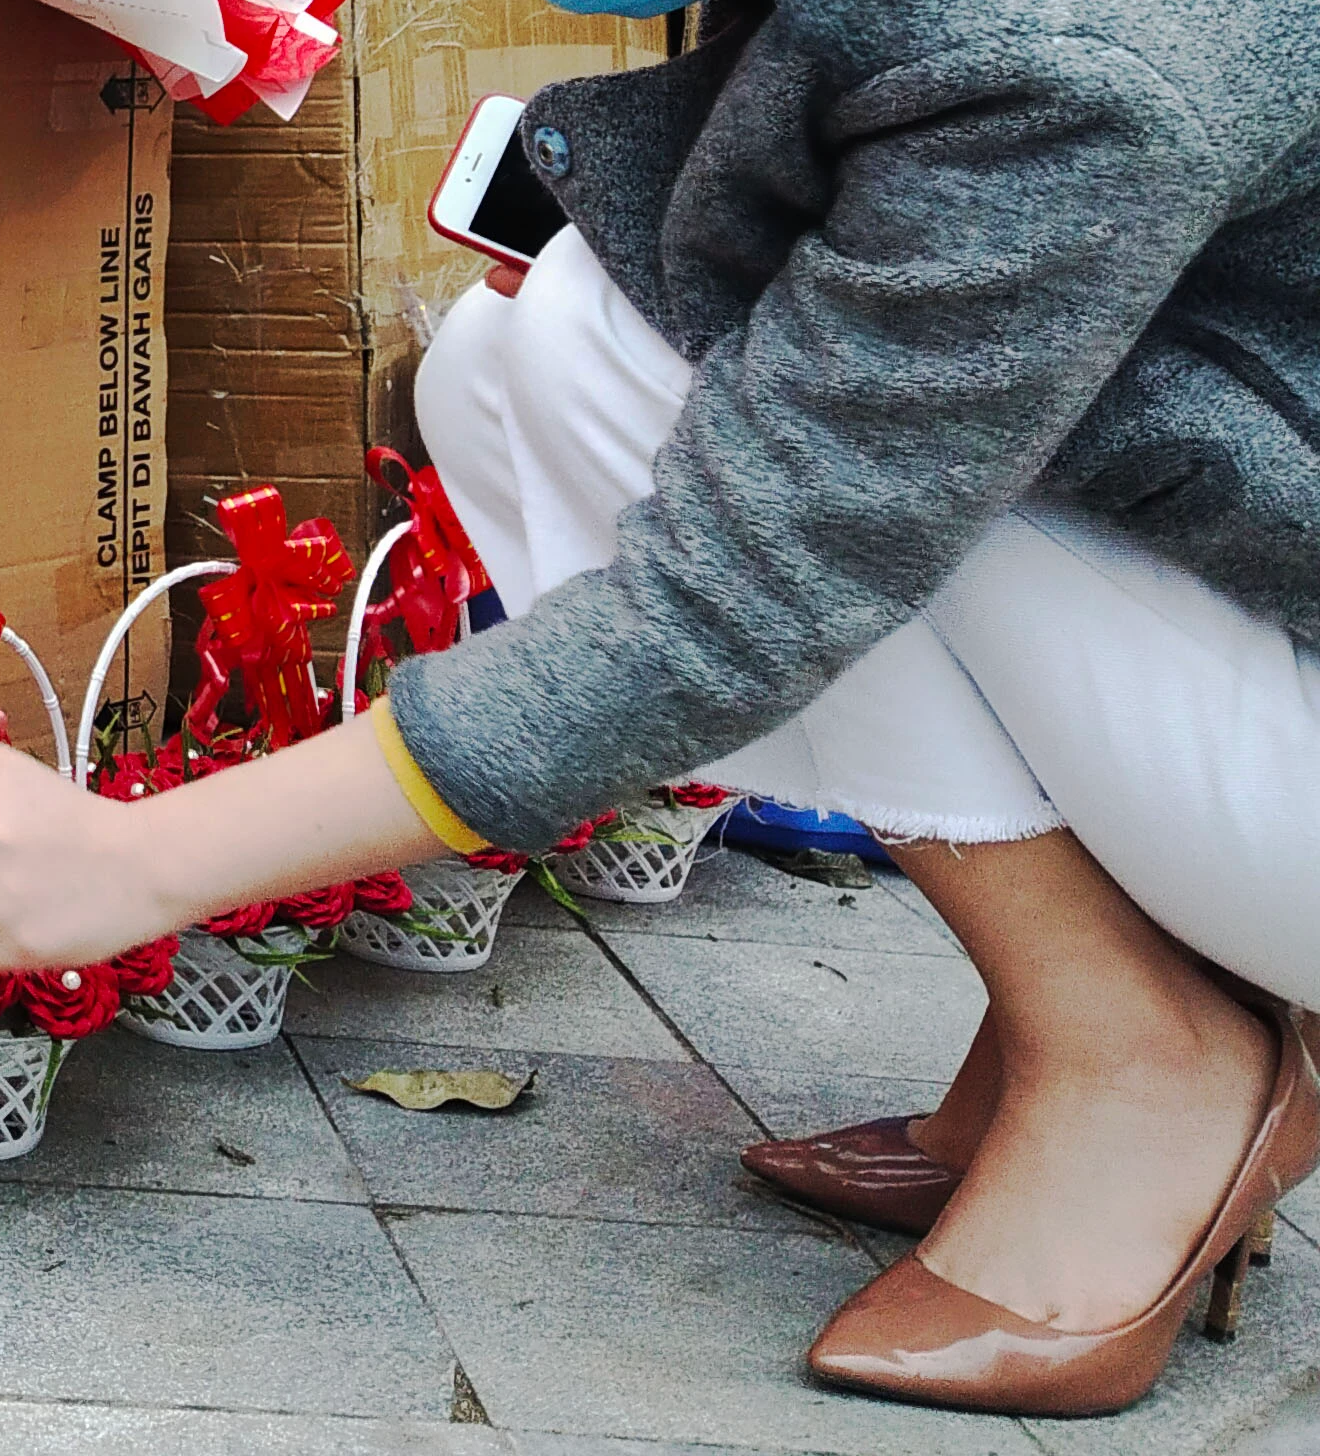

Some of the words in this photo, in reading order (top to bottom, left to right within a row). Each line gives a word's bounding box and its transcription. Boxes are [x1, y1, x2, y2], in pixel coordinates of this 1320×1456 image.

[99, 226, 121, 304] LINE
[132, 192, 155, 302] GARIS
[97, 313, 120, 437] BELOW
[132, 311, 152, 442] BAWAH
[97, 446, 119, 569] CLAMP
[132, 452, 152, 489] DI
